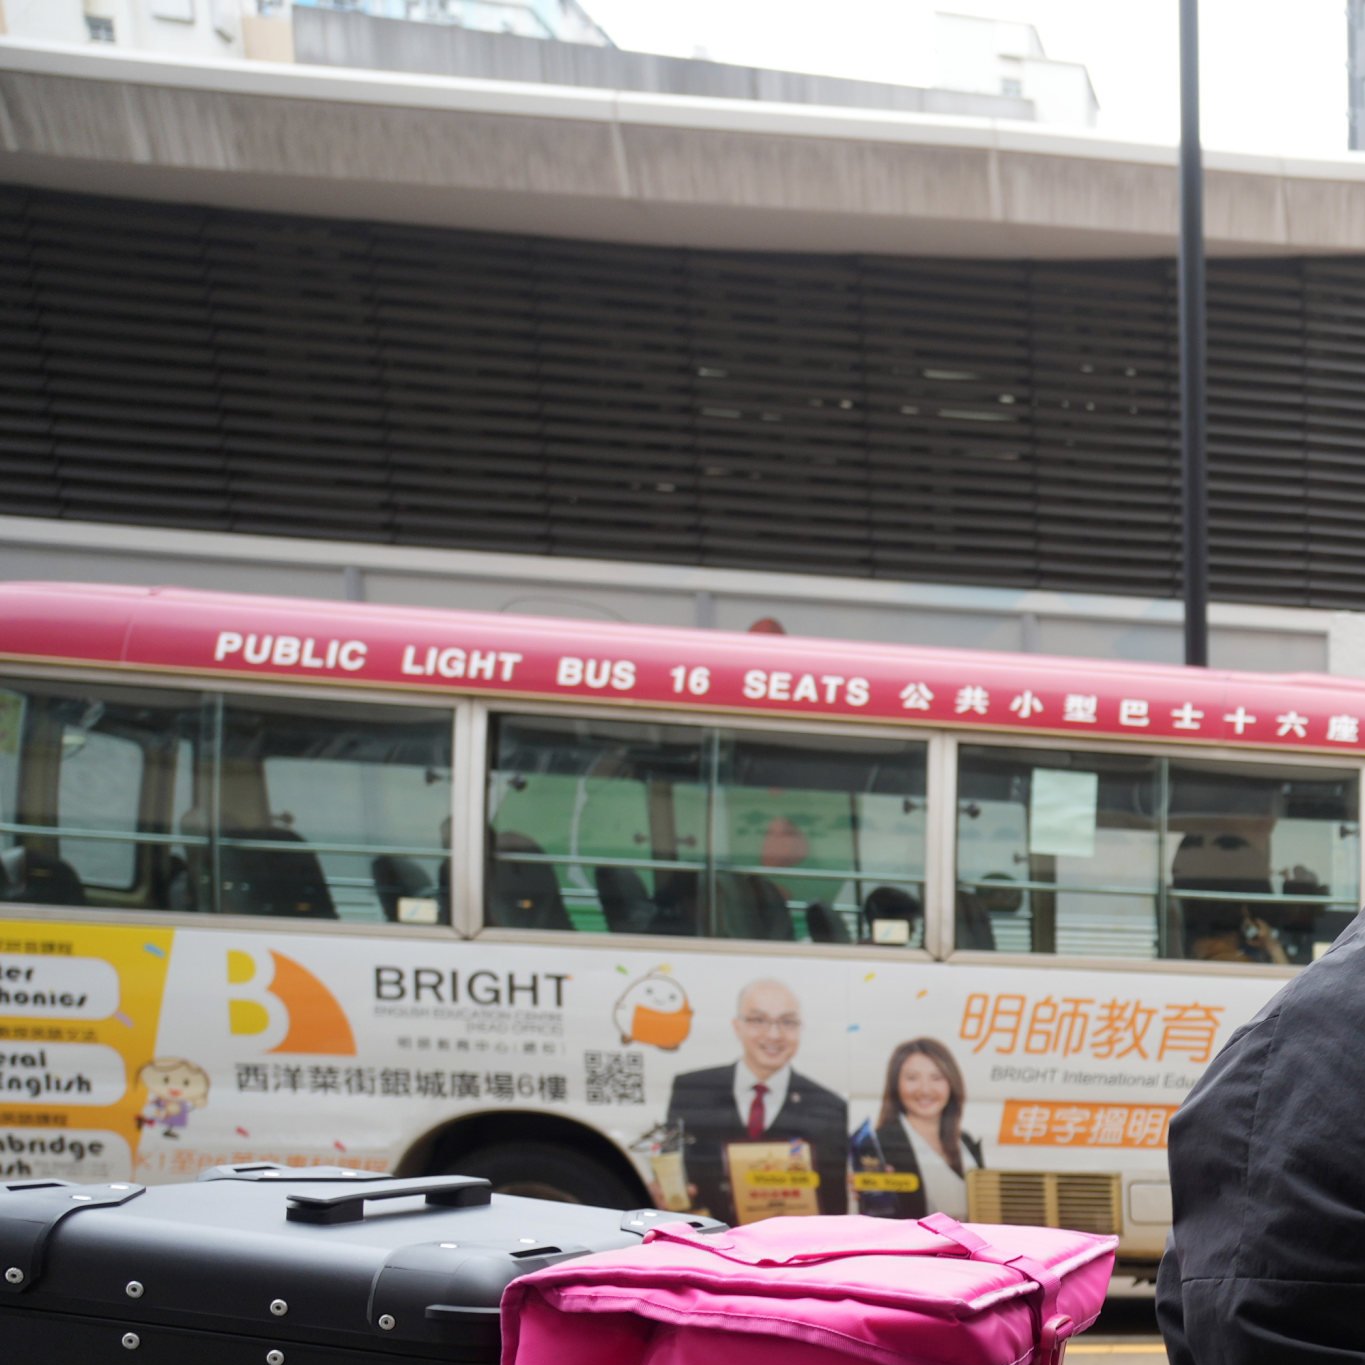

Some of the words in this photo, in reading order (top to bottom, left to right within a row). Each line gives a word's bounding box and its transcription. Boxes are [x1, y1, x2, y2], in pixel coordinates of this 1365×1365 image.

[214, 632, 367, 671] PUBLIC
[402, 646, 522, 681] LIGHT
[556, 657, 636, 690] BUS
[670, 666, 711, 695] 16
[743, 669, 870, 706] SEATS
[375, 966, 570, 1007] BRIGHT
[959, 993, 1225, 1063] 明師教育
[991, 1065, 1057, 1083] BRIGHT
[1063, 1069, 1159, 1087] International
